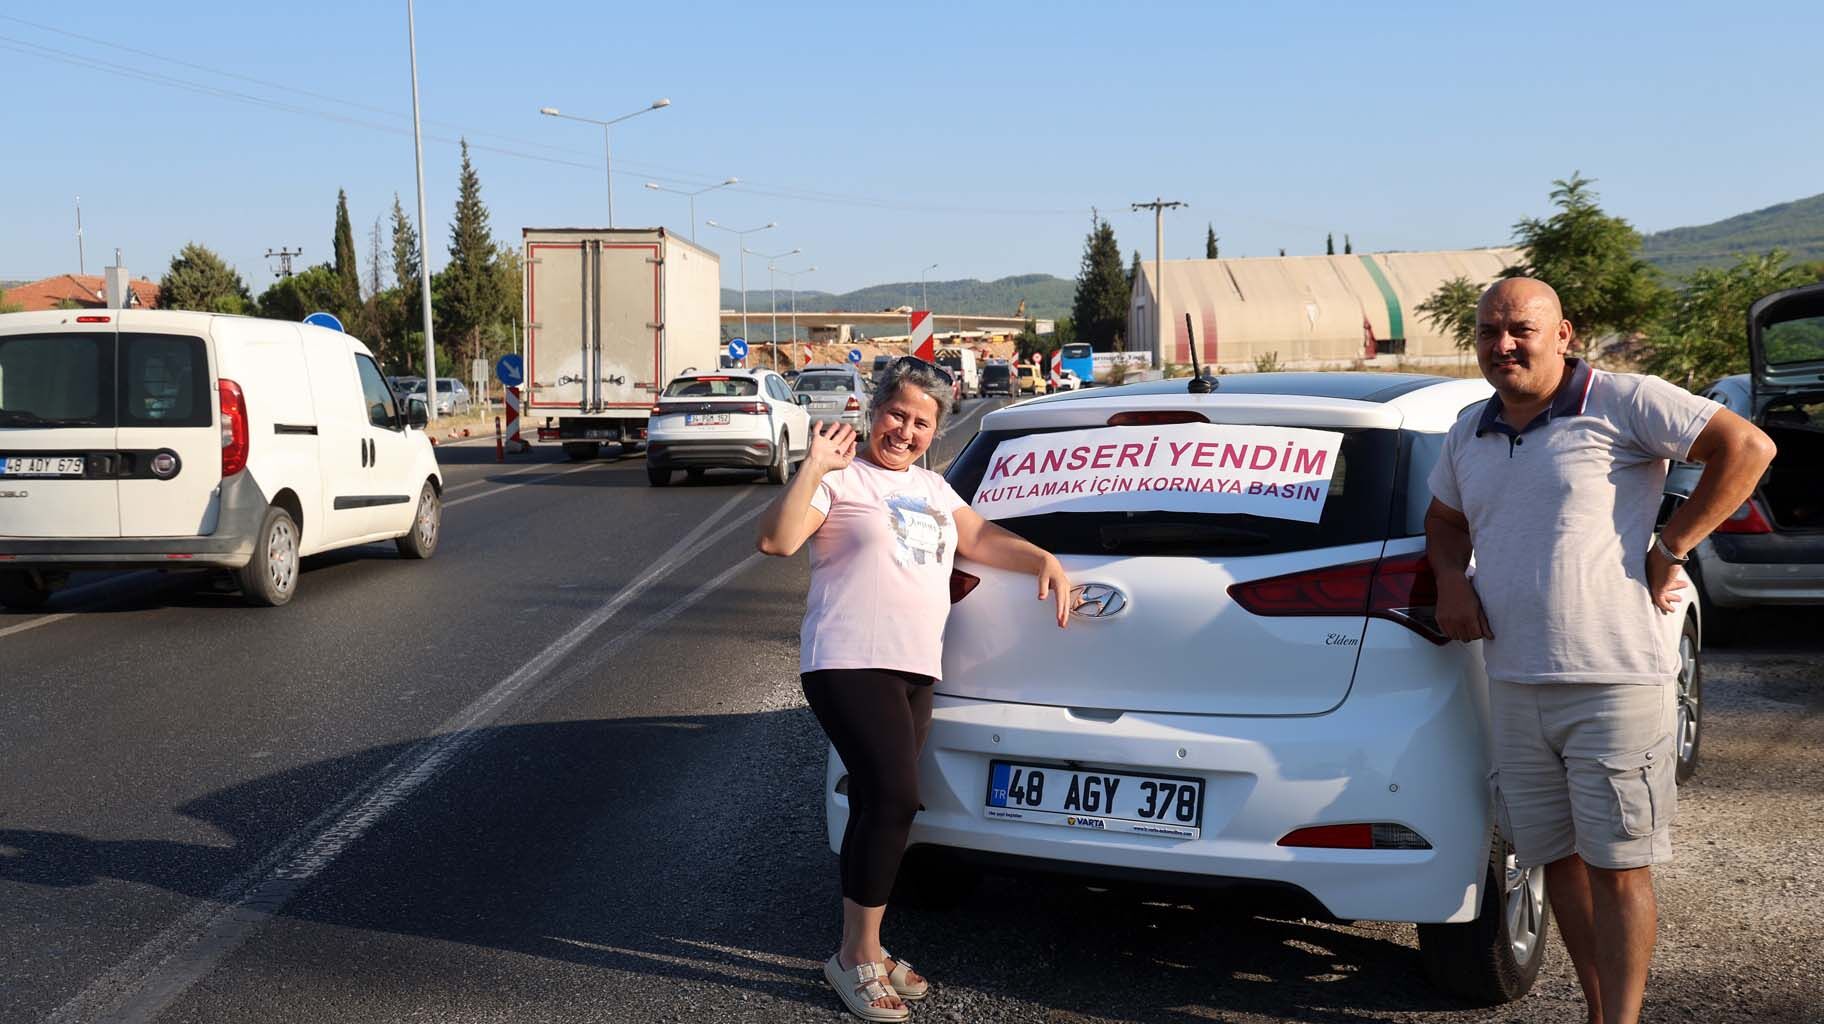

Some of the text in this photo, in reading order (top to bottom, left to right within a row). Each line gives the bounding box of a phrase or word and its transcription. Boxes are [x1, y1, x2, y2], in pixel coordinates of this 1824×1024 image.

[7, 458, 82, 472] 48 ADY 679
[990, 436, 1328, 481] KANSERİ YENDİM
[977, 475, 1320, 504] KUTLAMAK İÇİN KORNAYA BASIN
[1325, 632, 1359, 646] Eldem
[993, 789, 1007, 800] TR
[1008, 769, 1196, 822] 48 AGY 378
[1076, 817, 1105, 828] VARTA
